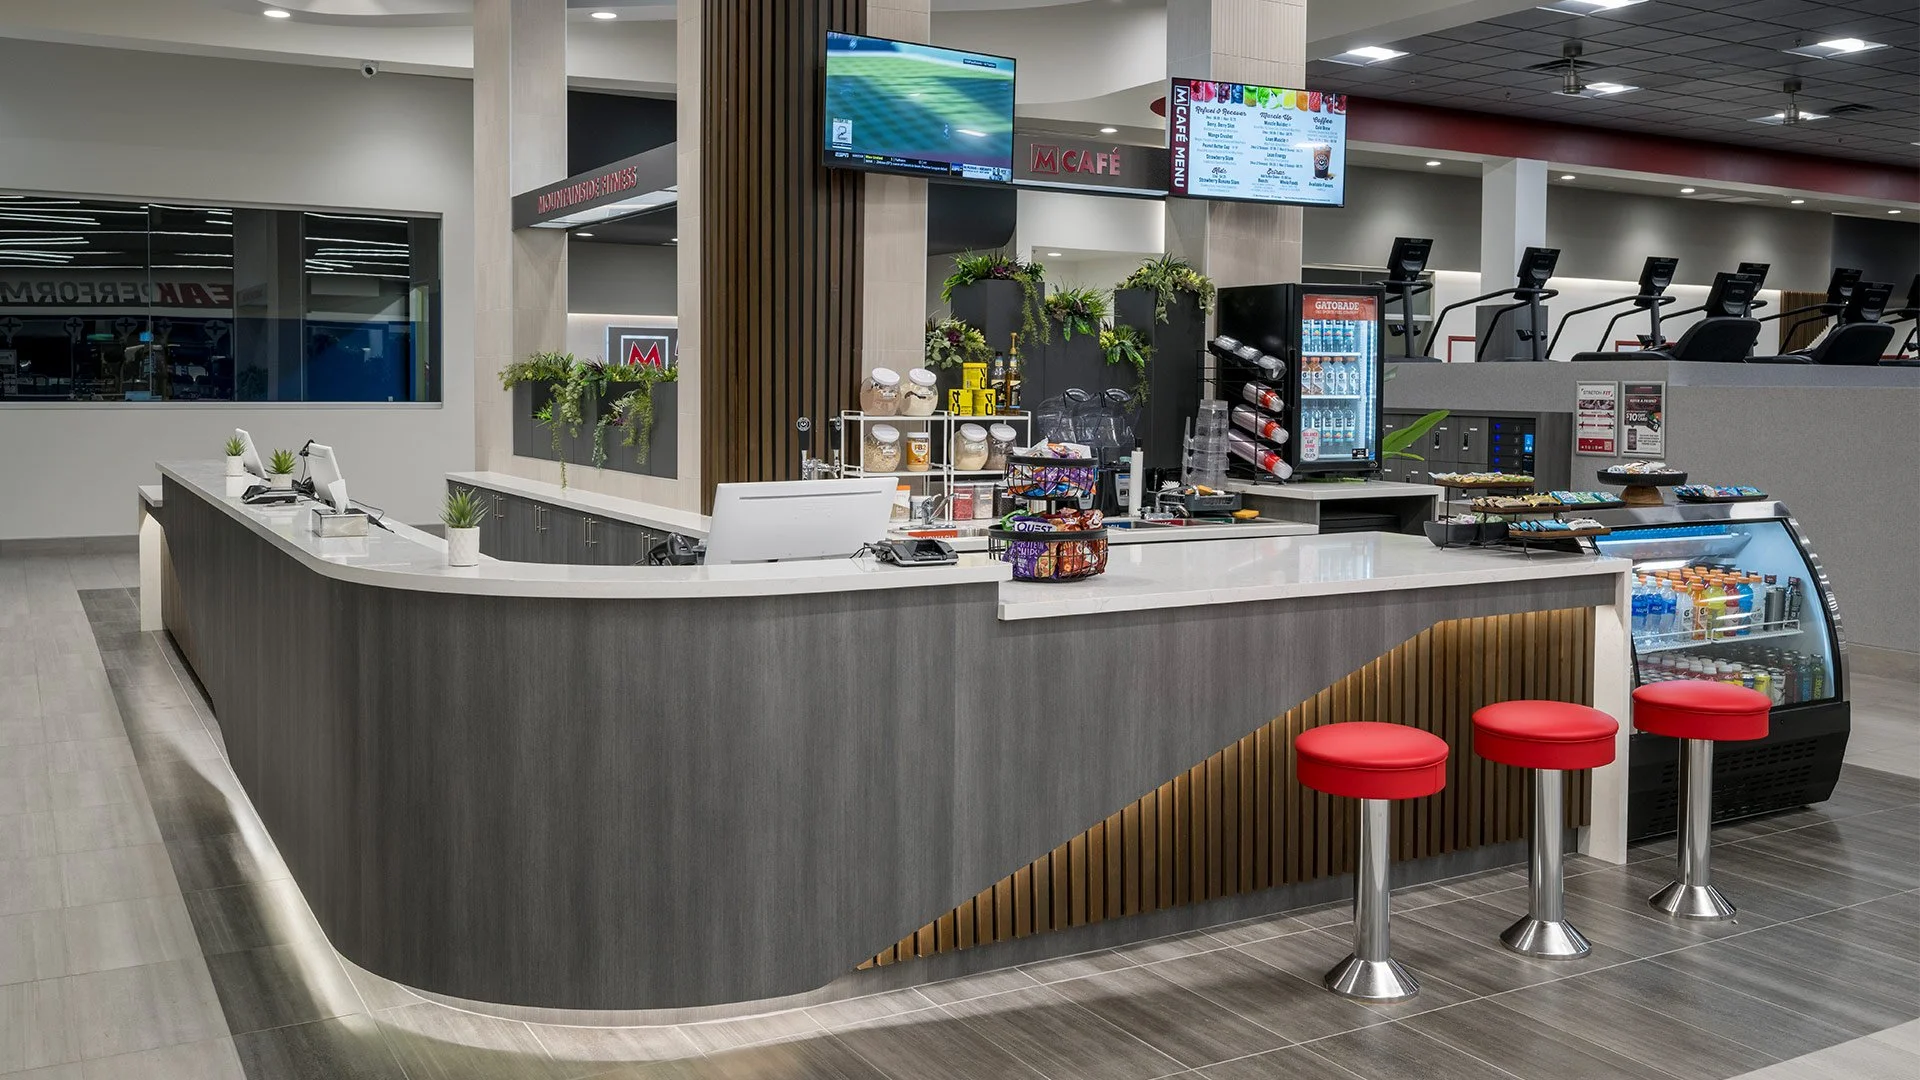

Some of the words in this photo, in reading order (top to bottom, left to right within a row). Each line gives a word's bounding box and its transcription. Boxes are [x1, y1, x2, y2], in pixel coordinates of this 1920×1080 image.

[1195, 105, 1215, 114] Refuel
[1222, 108, 1247, 116] Recover
[1175, 106, 1188, 142] CAFÉ
[1312, 116, 1333, 125] Coffee
[1061, 146, 1121, 176] CAFÉ
[1174, 146, 1186, 188] MENU
[538, 177, 600, 214] MOUNTAINSIDE
[601, 166, 637, 196] FITNESS
[1315, 301, 1360, 311] GATORADE
[951, 390, 960, 416] C4
[985, 393, 994, 416] C4
[1626, 413, 1638, 422] $10
[1017, 522, 1053, 532] QUEST
[1683, 609, 1690, 617] G
